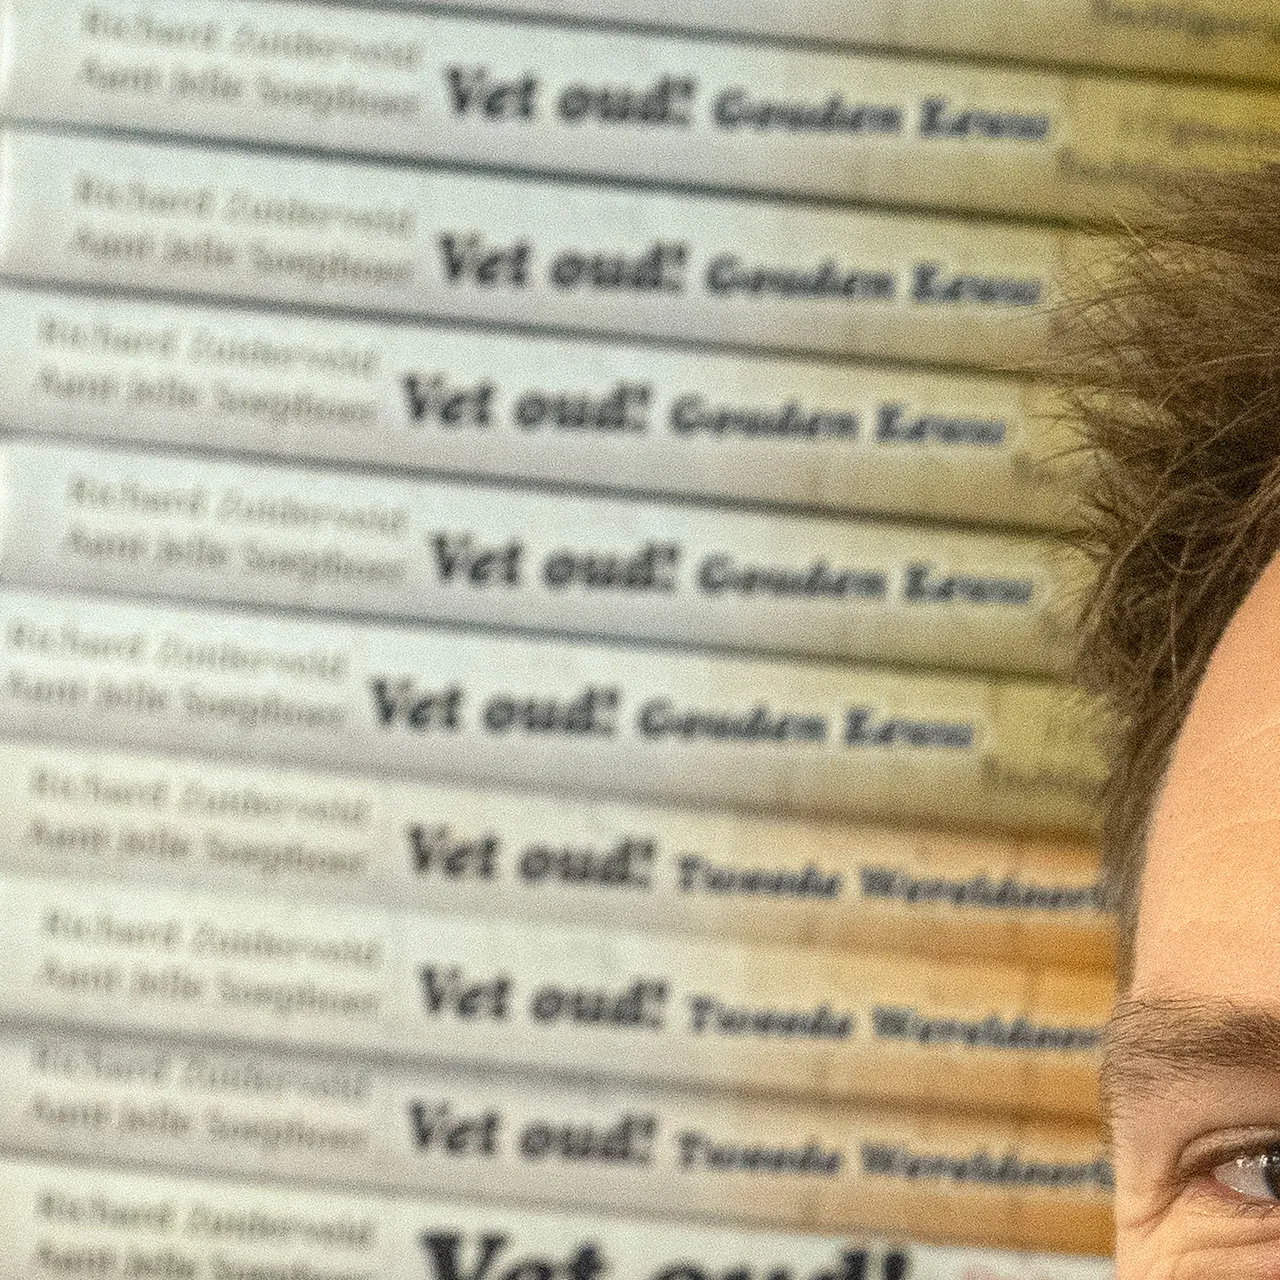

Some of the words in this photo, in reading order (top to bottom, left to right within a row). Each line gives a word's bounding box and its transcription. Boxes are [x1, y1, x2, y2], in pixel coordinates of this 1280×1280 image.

[442, 63, 539, 124] Vet
[554, 72, 696, 128] oud!
[710, 85, 903, 133] Gouden
[435, 230, 532, 291] Vet
[547, 239, 689, 295] oud!
[703, 252, 896, 300] Gouden
[399, 370, 496, 431] Vet
[511, 379, 653, 435] oud!
[667, 392, 860, 440] Gouden
[427, 529, 524, 590] Vet
[539, 538, 681, 594] oud!
[695, 551, 888, 599] Gouden
[367, 674, 464, 735] Vet
[479, 683, 621, 739] oud!
[635, 696, 828, 744] Gouden
[405, 821, 502, 883] Vet
[515, 833, 658, 889] oud!
[417, 962, 514, 1024] Vet
[527, 974, 670, 1030] oud!
[406, 1098, 503, 1160] Vet
[516, 1110, 659, 1166] oud!
